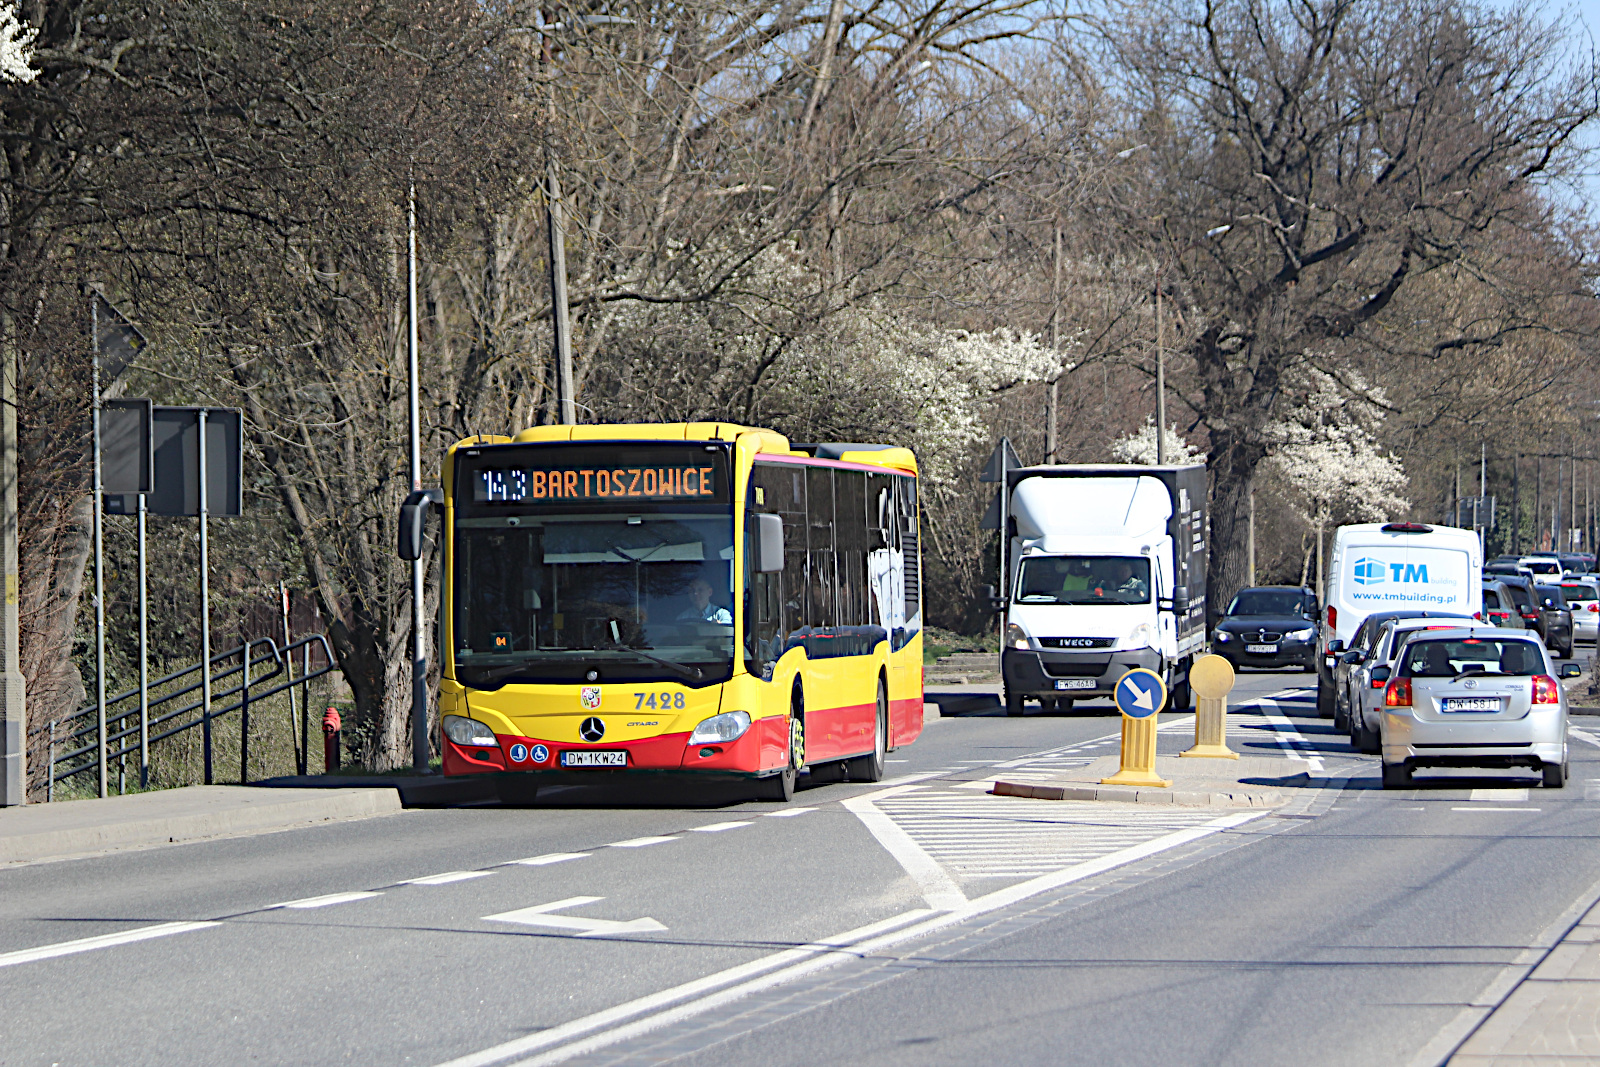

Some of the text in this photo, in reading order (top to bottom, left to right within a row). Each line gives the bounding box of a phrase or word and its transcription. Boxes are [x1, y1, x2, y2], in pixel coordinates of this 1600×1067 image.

[532, 467, 713, 498] BARTOSZOWICE
[1390, 563, 1457, 587] TM building
[1353, 592, 1457, 604] www.tmbuilding.pl
[496, 636, 507, 646] 04
[634, 692, 686, 710] 7428
[1449, 699, 1498, 710] DW 158JT
[569, 753, 623, 764] DW 1KW24
